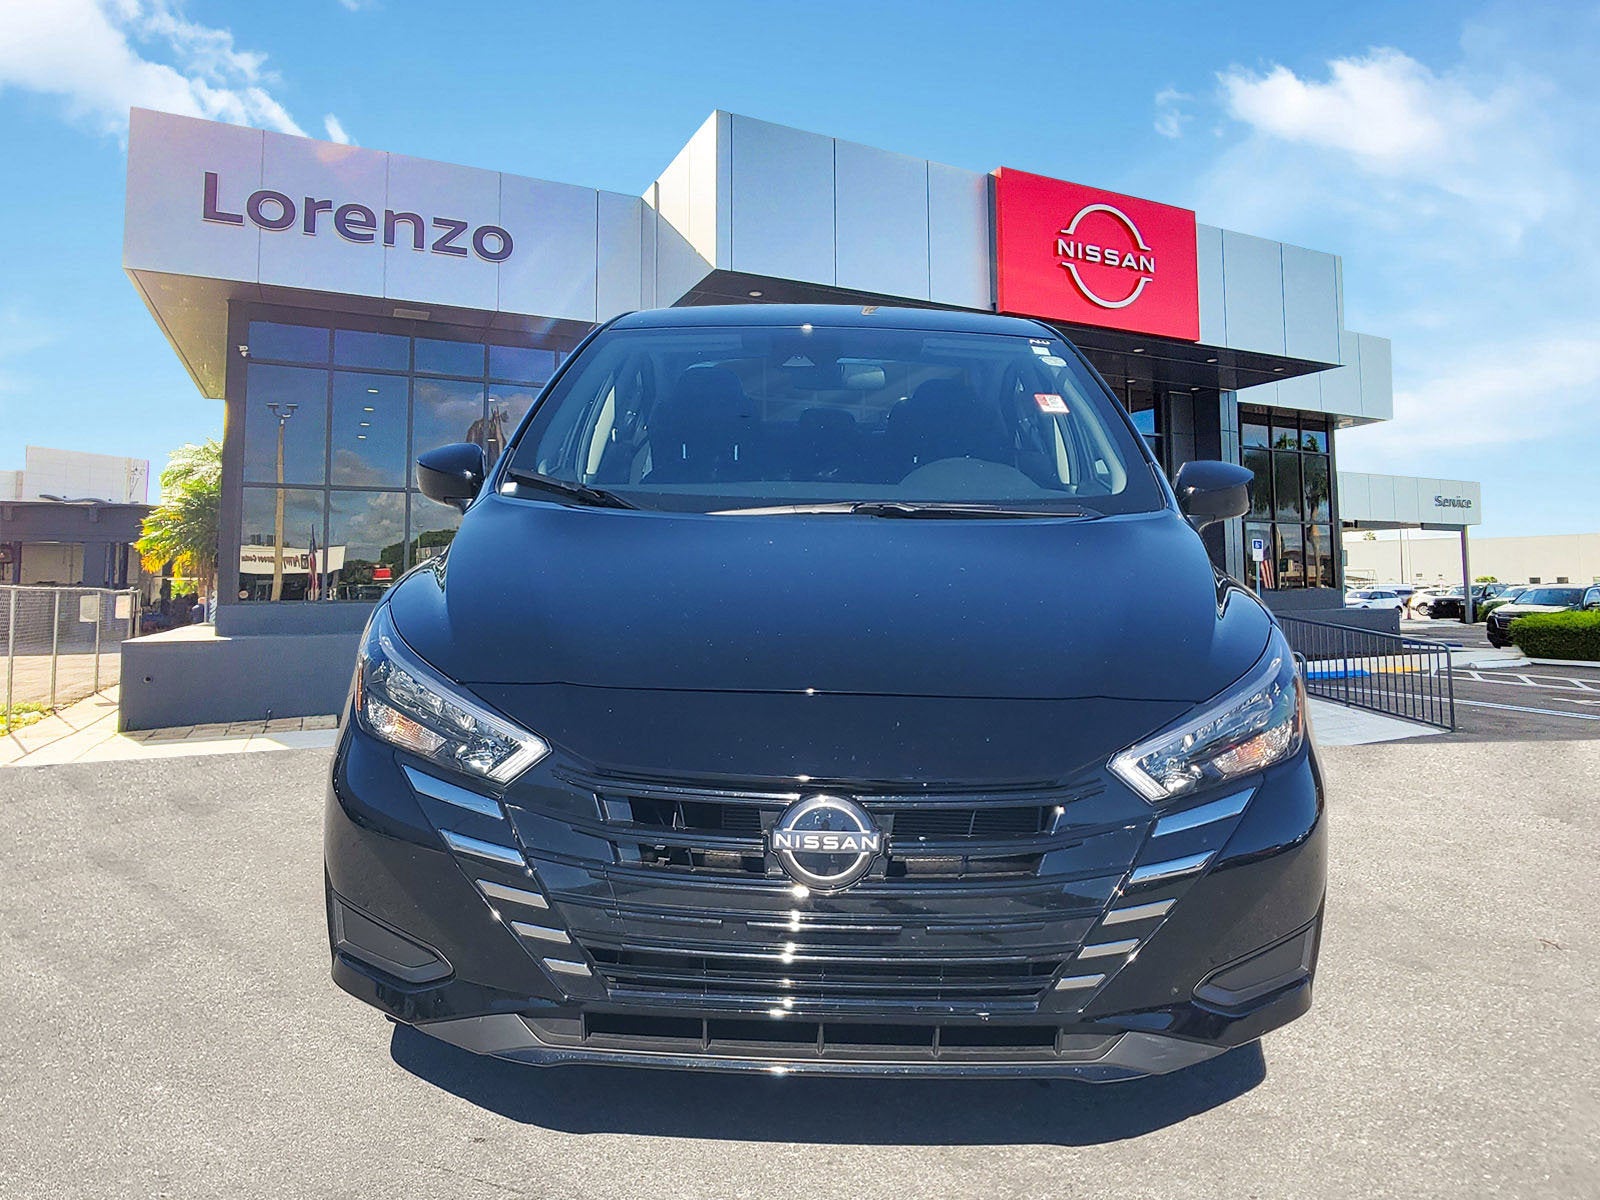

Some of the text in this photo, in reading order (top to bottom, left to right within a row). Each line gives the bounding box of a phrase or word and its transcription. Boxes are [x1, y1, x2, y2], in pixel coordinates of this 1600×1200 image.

[203, 171, 514, 262] Lorenzo
[1057, 238, 1155, 273] NISSAN
[1434, 495, 1472, 508] Service
[775, 833, 878, 850] NISSAN
